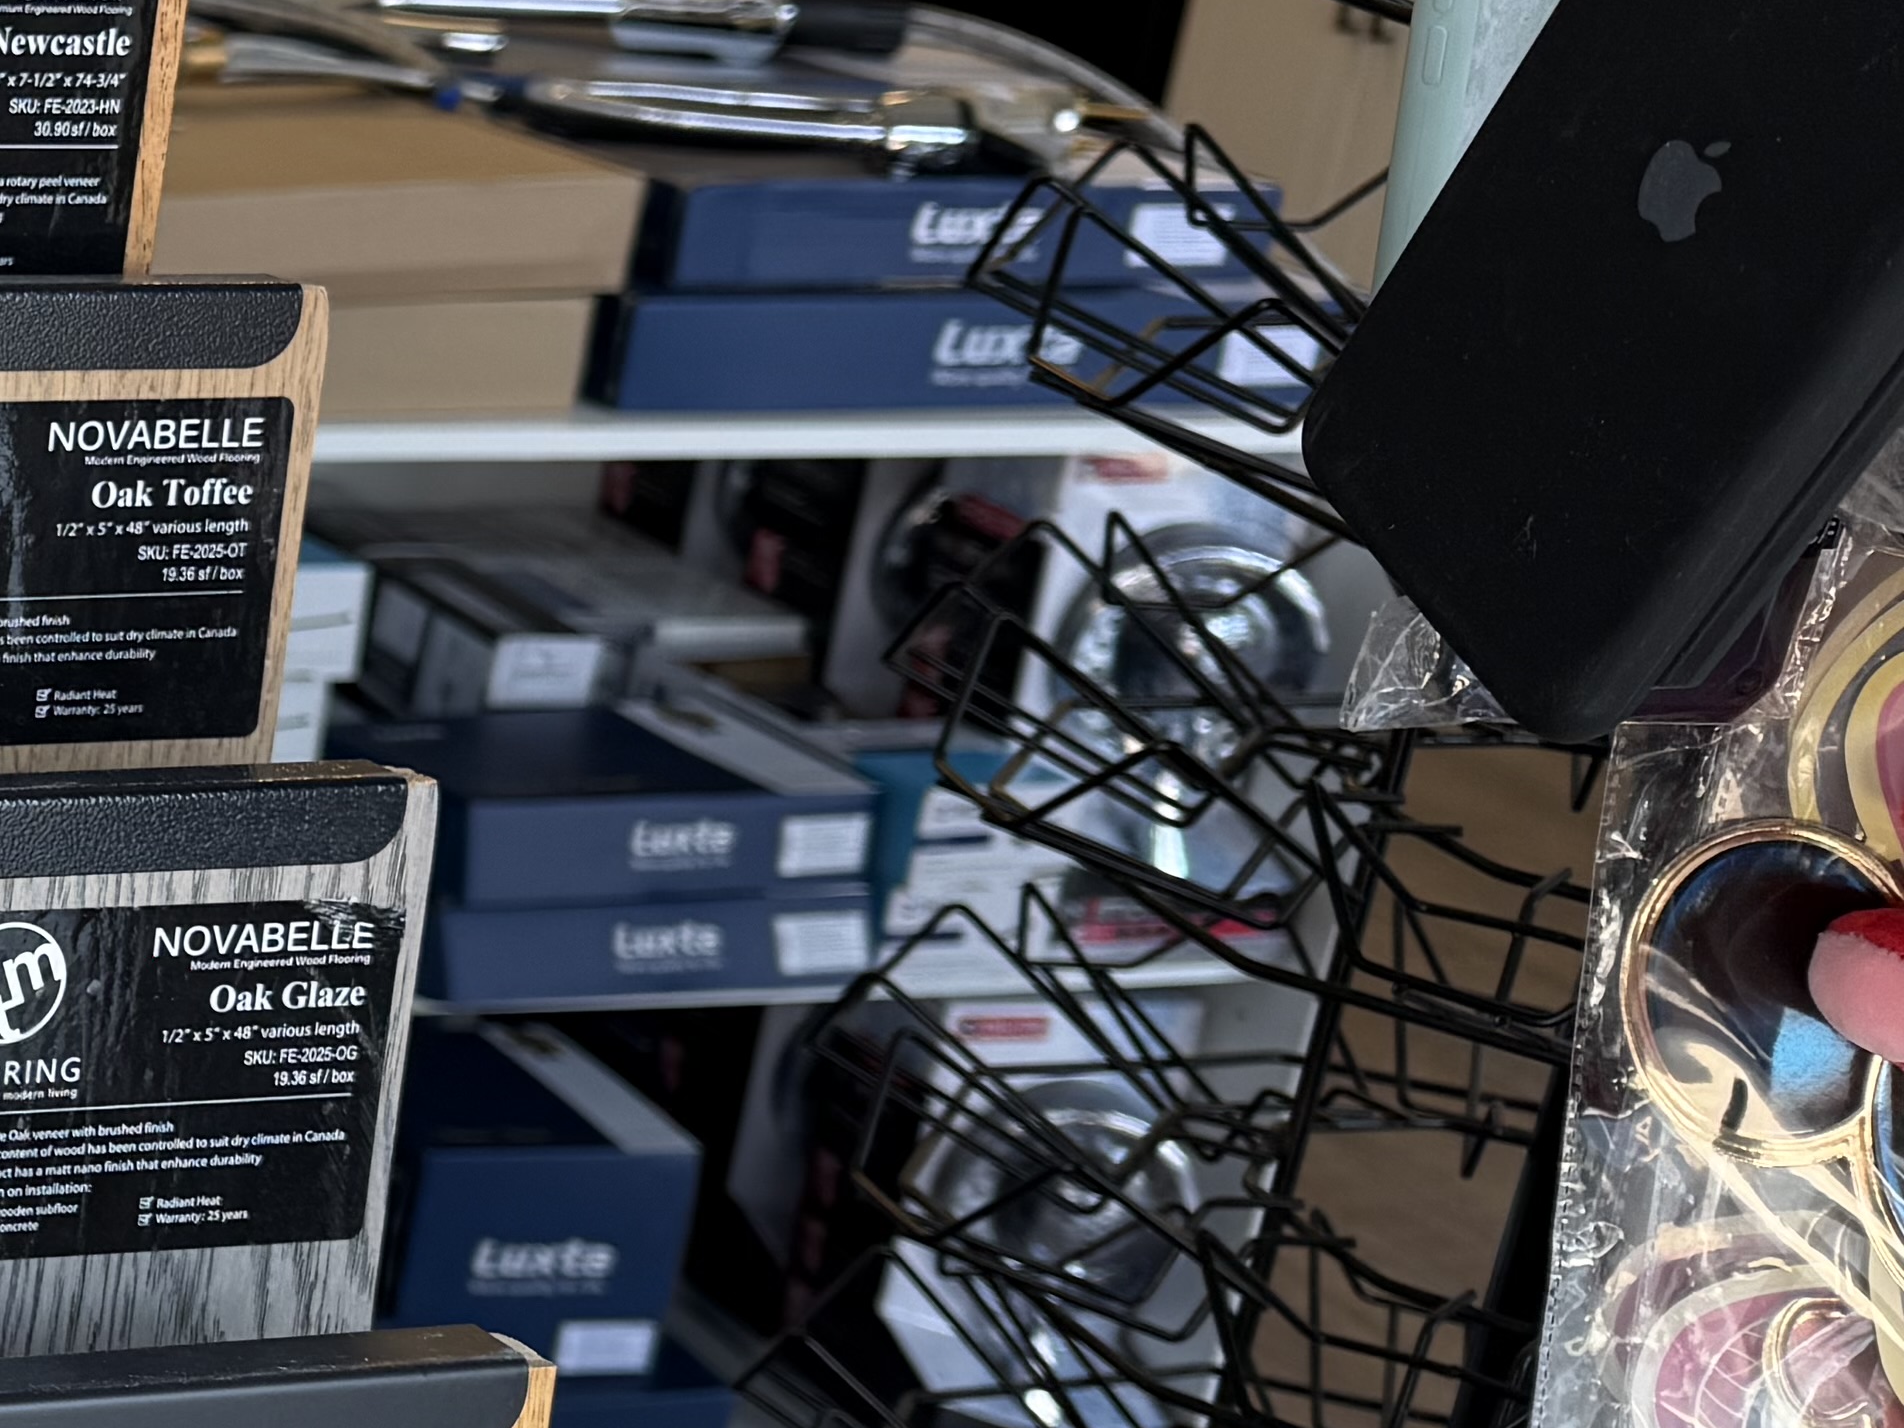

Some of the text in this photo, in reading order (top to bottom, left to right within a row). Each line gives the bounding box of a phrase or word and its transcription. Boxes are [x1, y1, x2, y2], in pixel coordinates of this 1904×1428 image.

[8, 97, 121, 115] SKU: FE-2023-HN
[47, 416, 265, 452] NOVABELLE
[90, 477, 254, 509] Oak Toffee
[136, 541, 248, 561] SKU: FE-2025-OT
[161, 565, 196, 582] 19.36
[197, 565, 211, 581] sf
[218, 565, 243, 581] box
[152, 918, 375, 958] NOVABELLE
[208, 979, 366, 1013] Oak Glaze
[243, 1044, 358, 1066] SKU: FE-2025-OG
[273, 1069, 307, 1086] 19.36
[308, 1067, 323, 1085] sf
[330, 1068, 355, 1084] box
